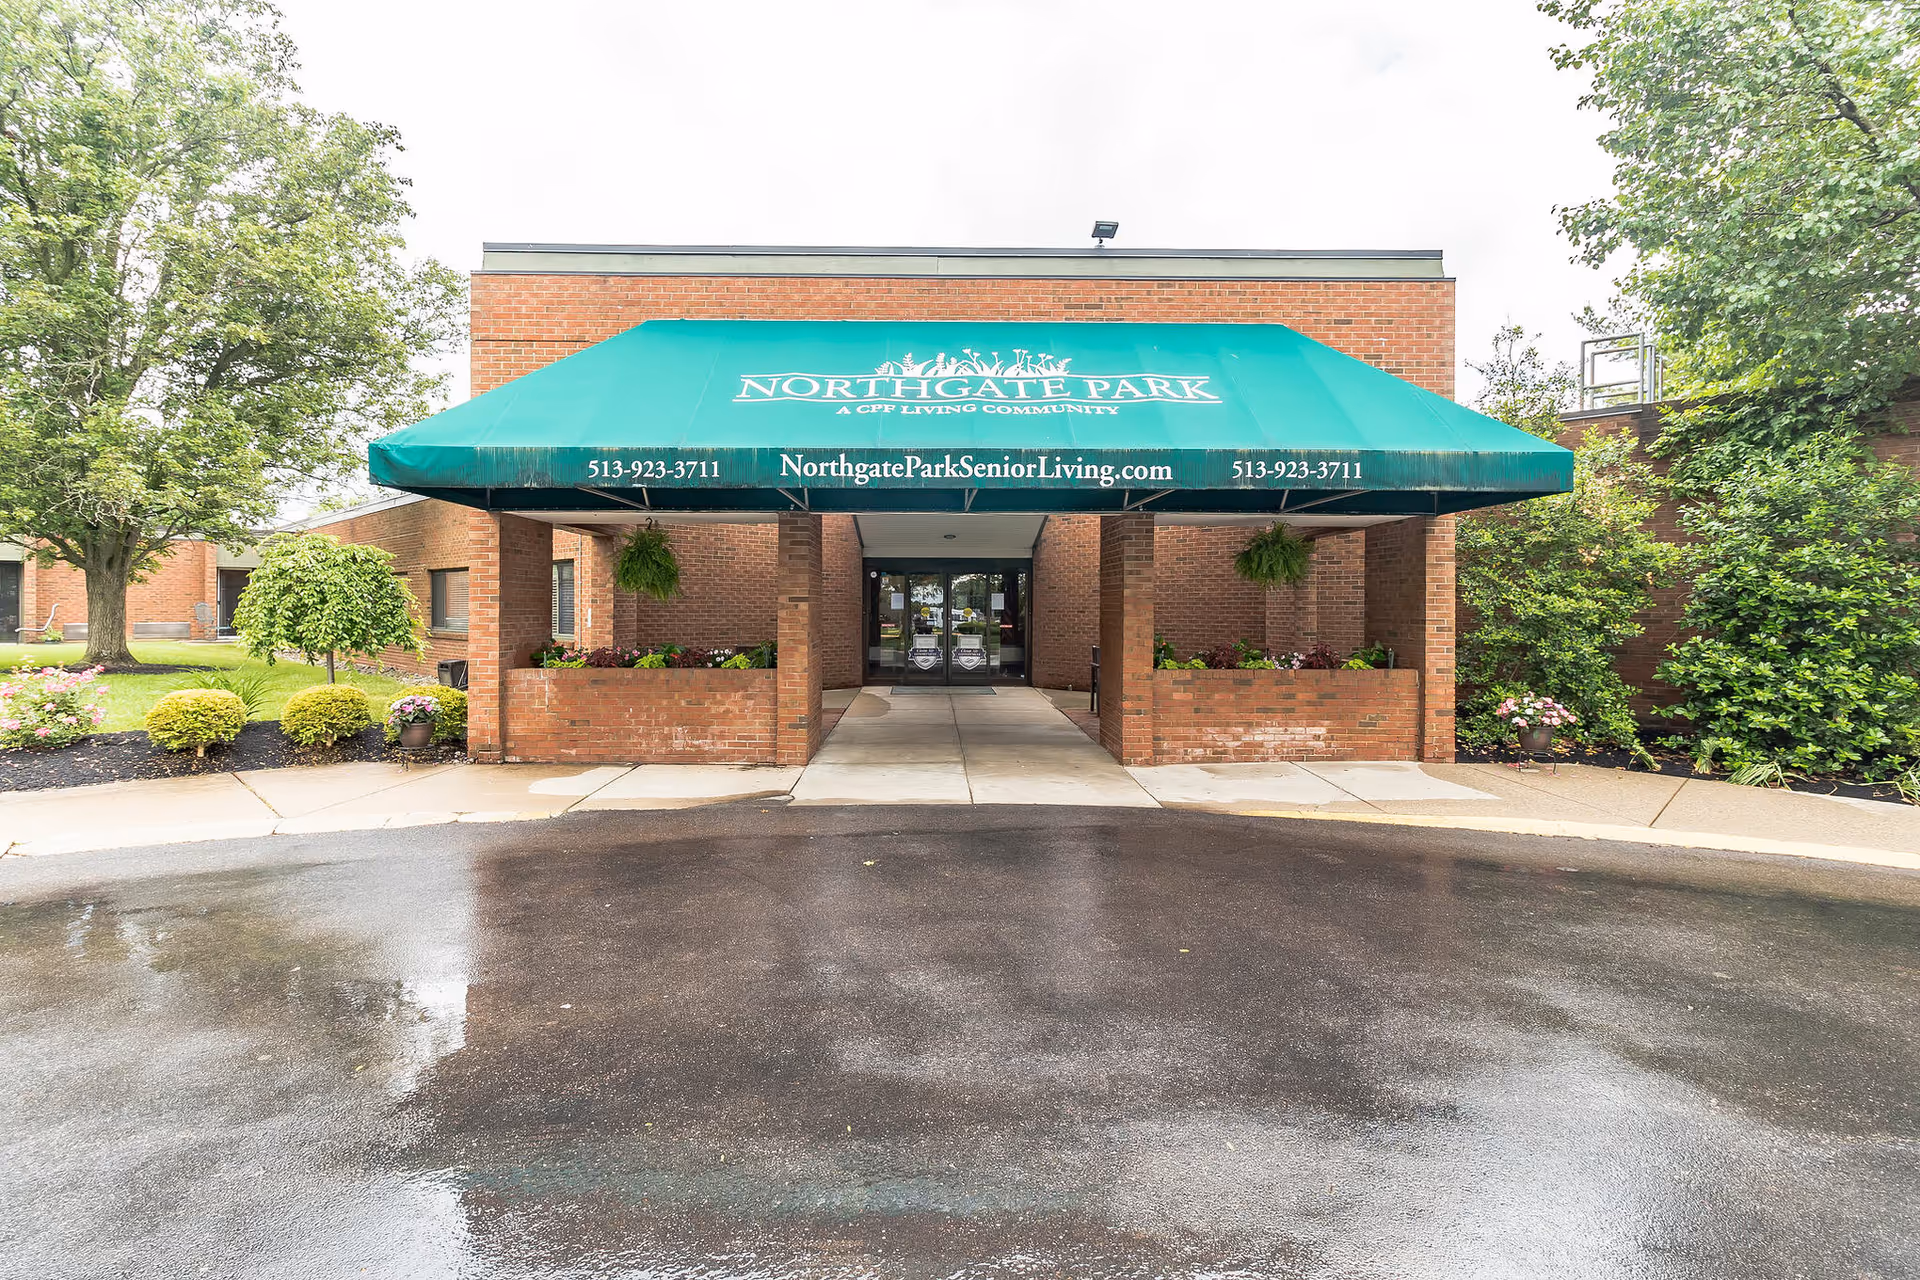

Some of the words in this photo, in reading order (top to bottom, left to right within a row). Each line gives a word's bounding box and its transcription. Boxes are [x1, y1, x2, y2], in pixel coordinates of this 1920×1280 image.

[736, 377, 1071, 399] NORTHGATE
[1082, 377, 1219, 400] PARK
[836, 405, 851, 415] A
[901, 404, 976, 415] LIVING
[982, 404, 1119, 415] COMMUNITY
[588, 460, 720, 479] 513-923-3711
[780, 453, 1173, 485] NorthgateParkSeniorLiving.com
[1232, 461, 1362, 480] 513-923-3711
